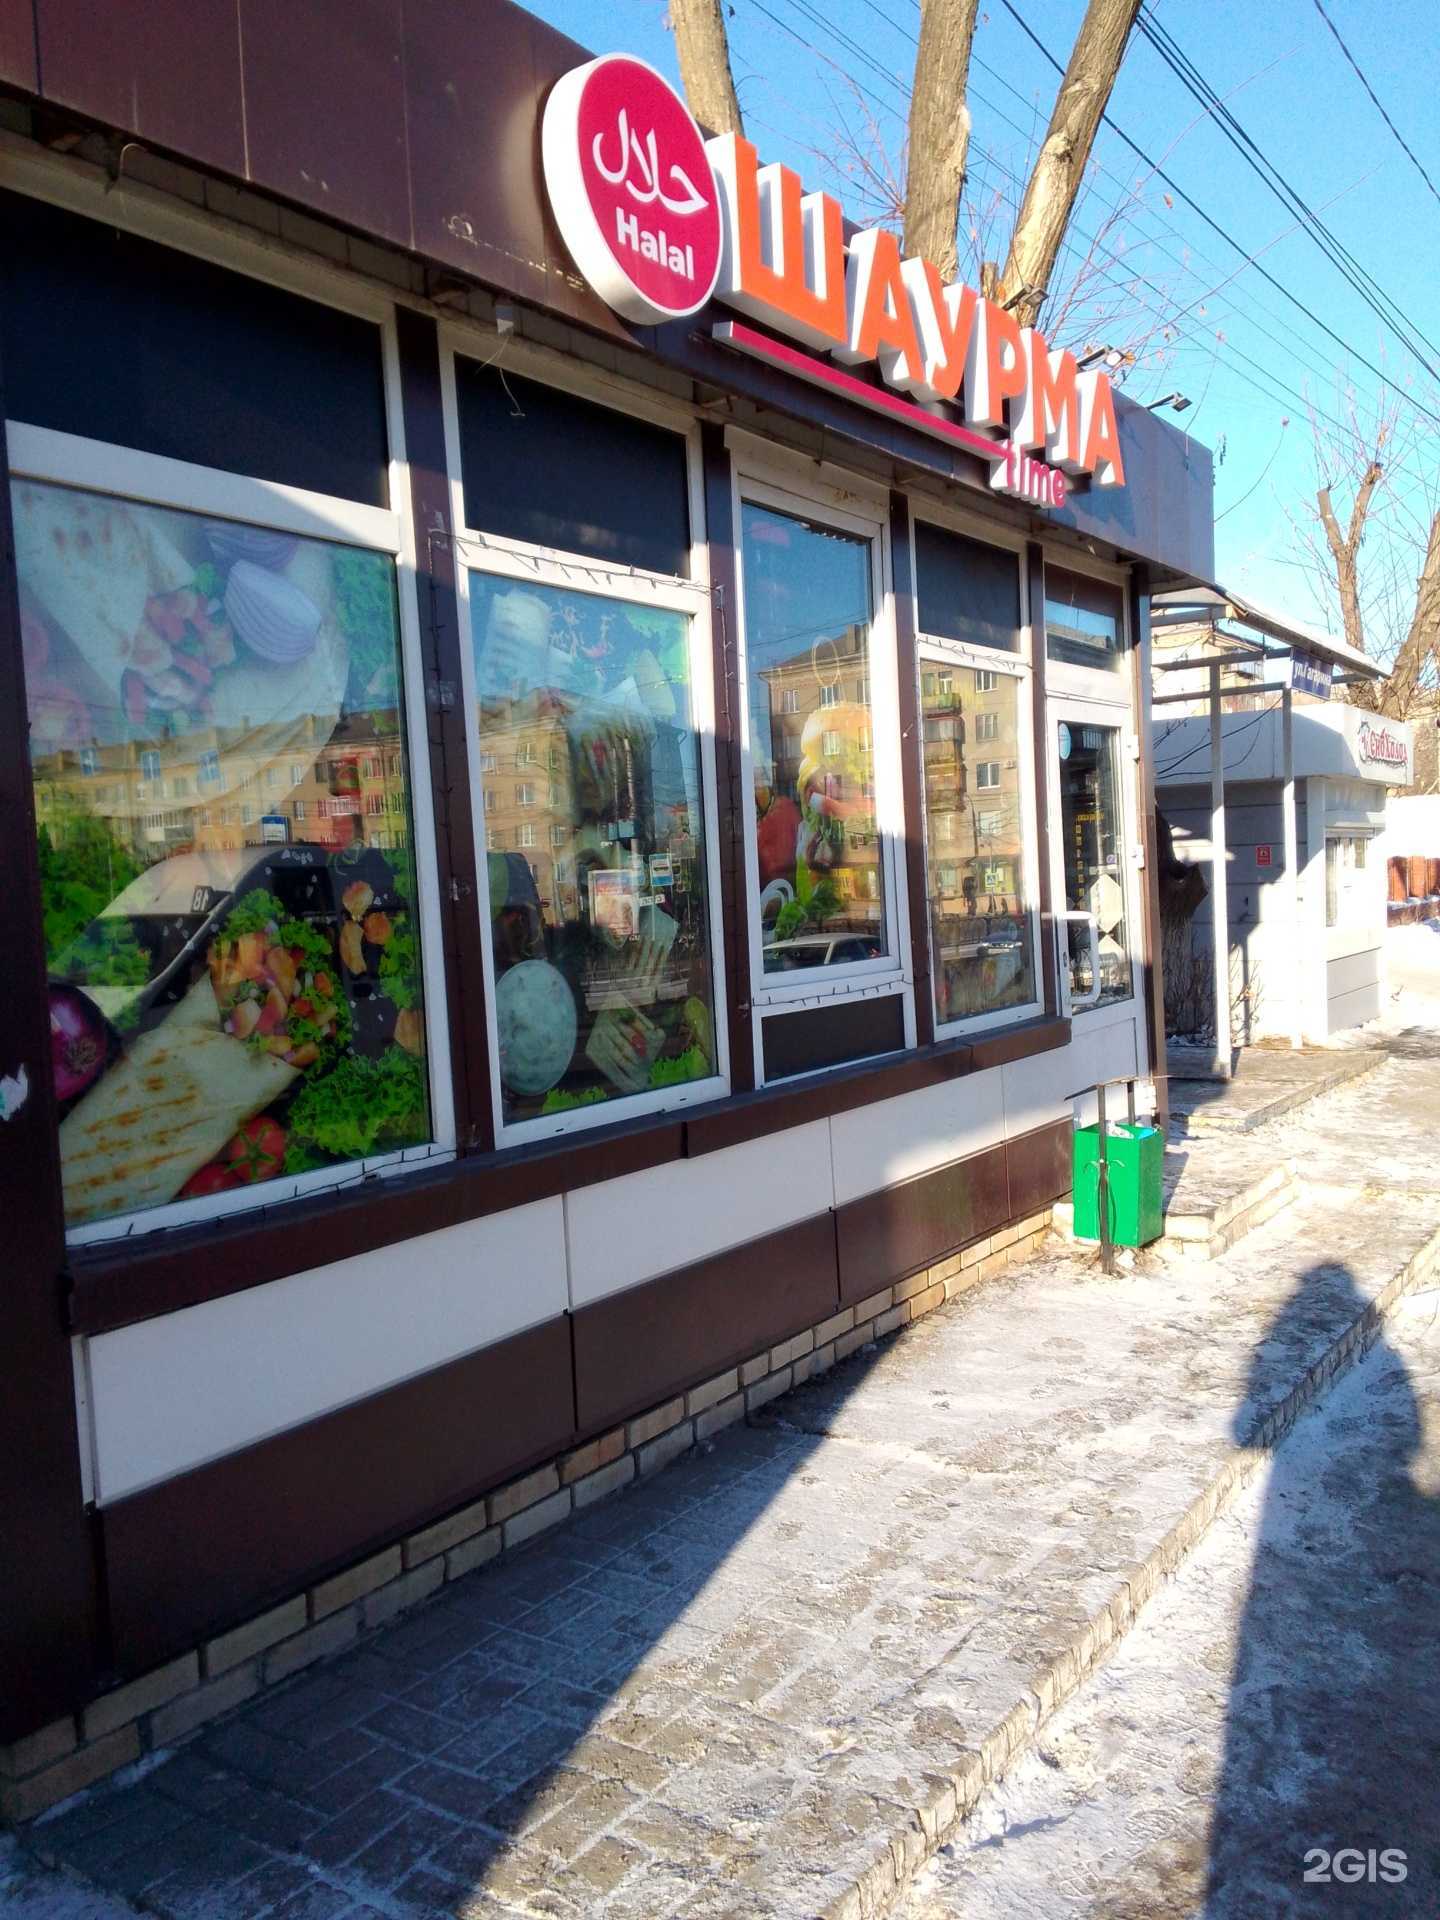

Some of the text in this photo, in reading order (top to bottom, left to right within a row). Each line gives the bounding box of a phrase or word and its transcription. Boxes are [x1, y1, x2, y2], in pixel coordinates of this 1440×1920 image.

[592, 107, 709, 215] حلال
[615, 206, 695, 281] Halal
[733, 131, 1126, 487] ШАУРМА
